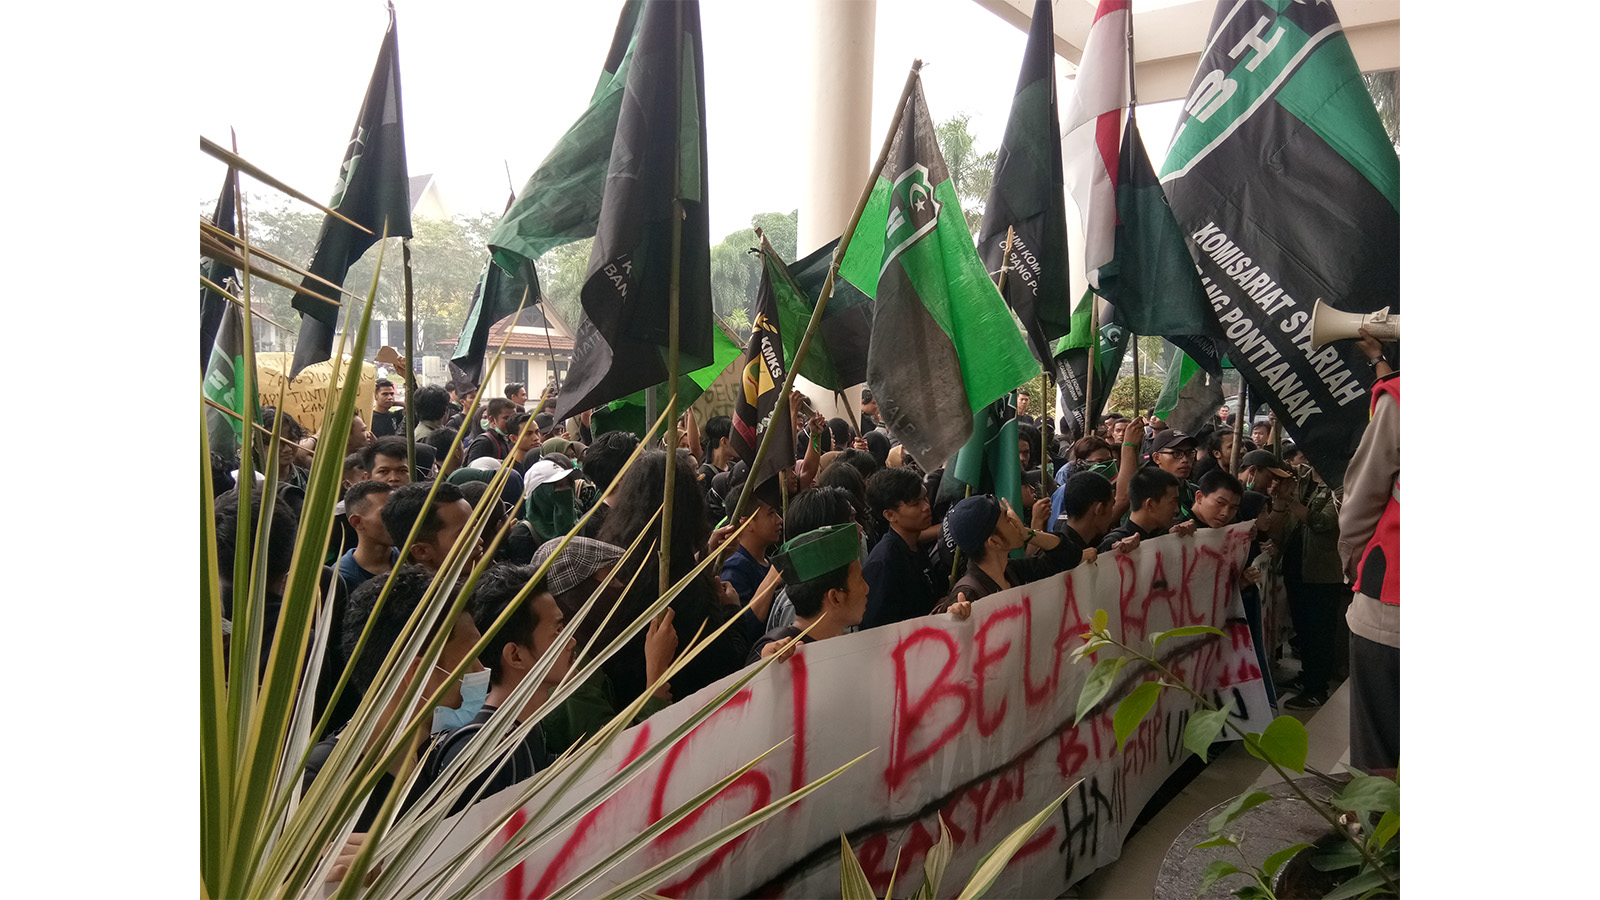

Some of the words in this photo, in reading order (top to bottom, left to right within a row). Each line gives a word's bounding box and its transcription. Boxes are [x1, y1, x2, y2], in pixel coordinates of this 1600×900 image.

[999, 240, 1032, 281] CBANG
[1192, 221, 1296, 316] KOMISARIAT
[761, 336, 783, 379] KMKS
[1219, 306, 1323, 429] PONTIANAK
[884, 572, 1097, 793] BELA
